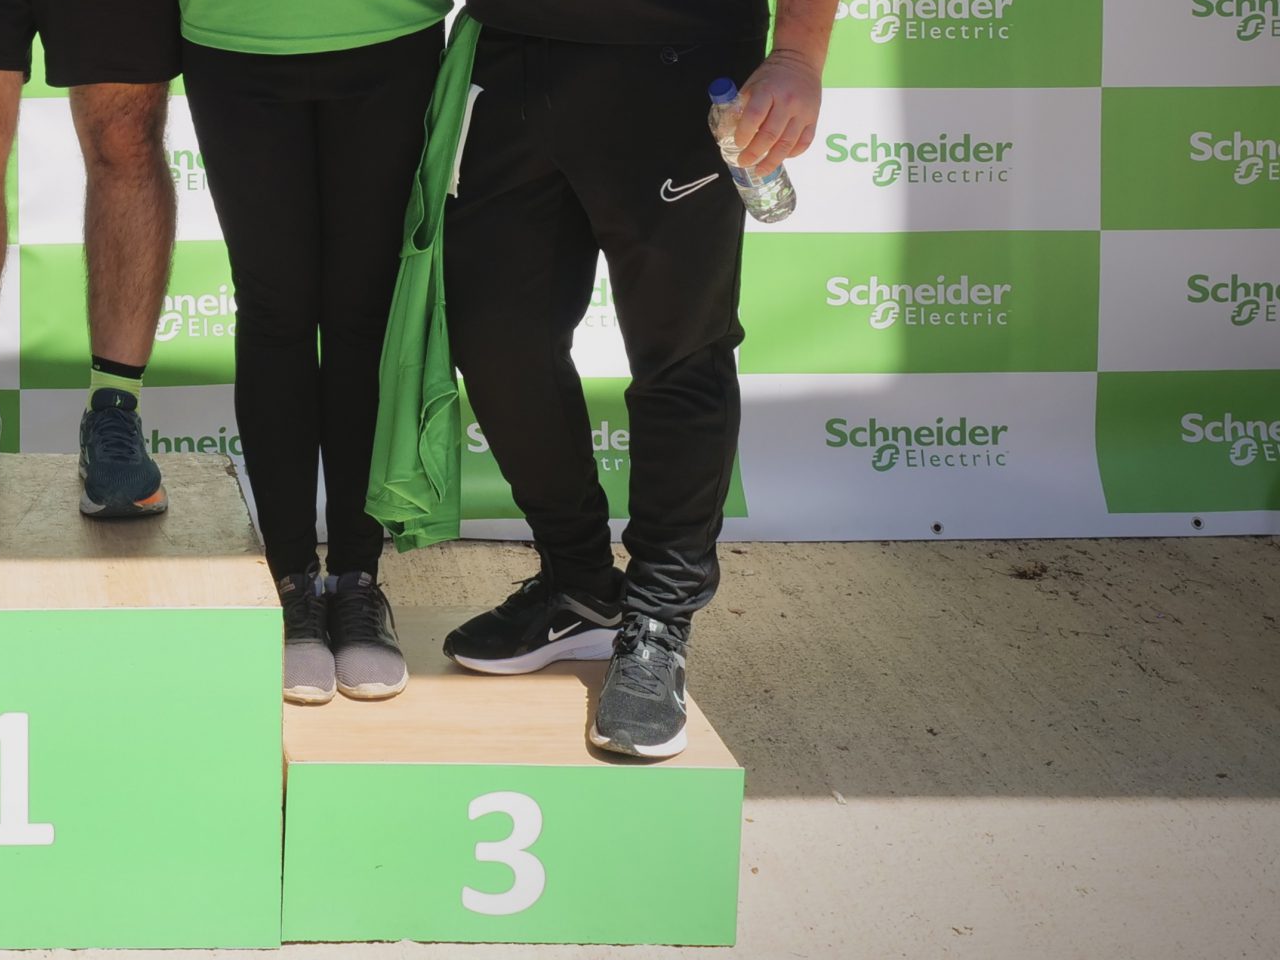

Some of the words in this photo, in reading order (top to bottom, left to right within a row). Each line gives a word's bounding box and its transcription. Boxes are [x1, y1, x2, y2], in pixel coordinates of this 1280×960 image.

[906, 22, 1009, 40] Electric
[826, 134, 1012, 164] Schneider
[908, 166, 1009, 184] Electric
[826, 276, 1012, 307] Schneider
[906, 308, 1008, 326] Electric
[825, 417, 1008, 448] Schneider
[906, 449, 1007, 468] Electric
[461, 791, 547, 916] 3
